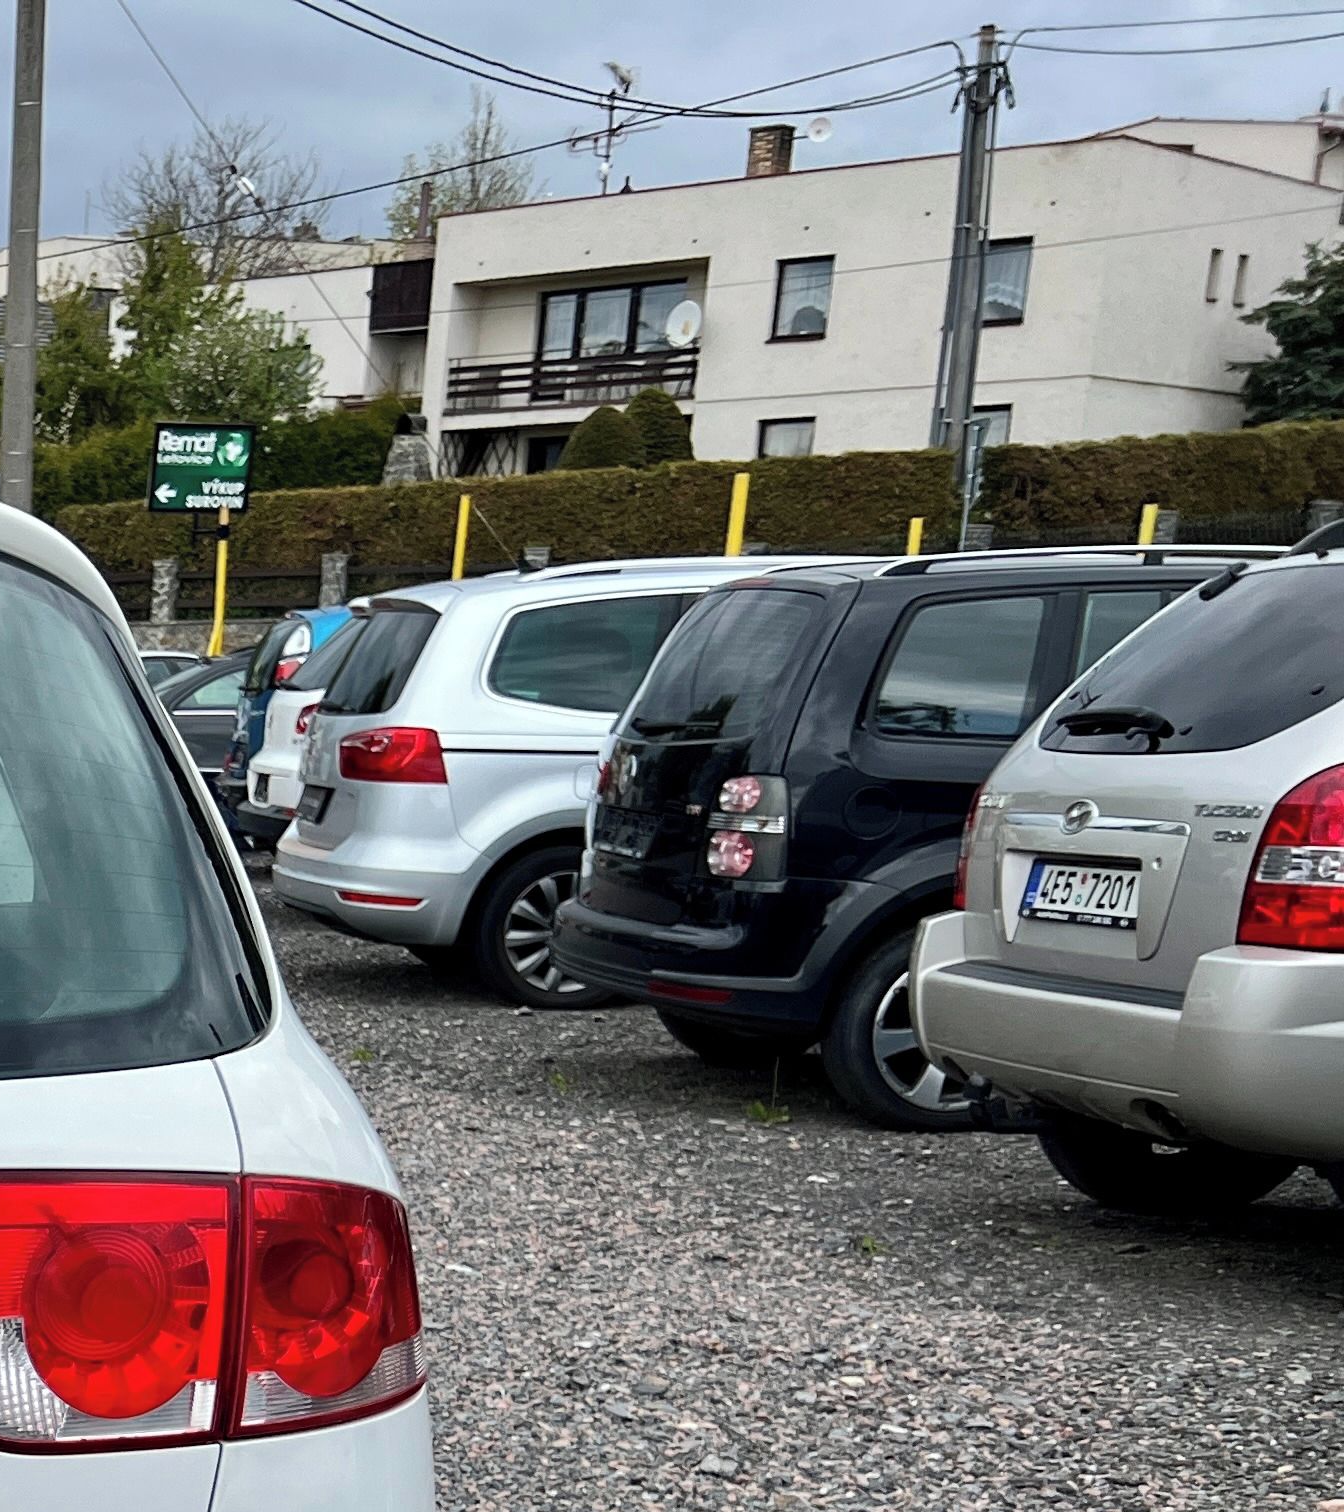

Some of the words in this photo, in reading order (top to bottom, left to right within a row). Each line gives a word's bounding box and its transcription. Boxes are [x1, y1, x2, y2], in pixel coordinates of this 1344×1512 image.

[157, 431, 217, 453] Remat
[1039, 869, 1078, 904] 4E5
[1084, 872, 1136, 912] 7201
